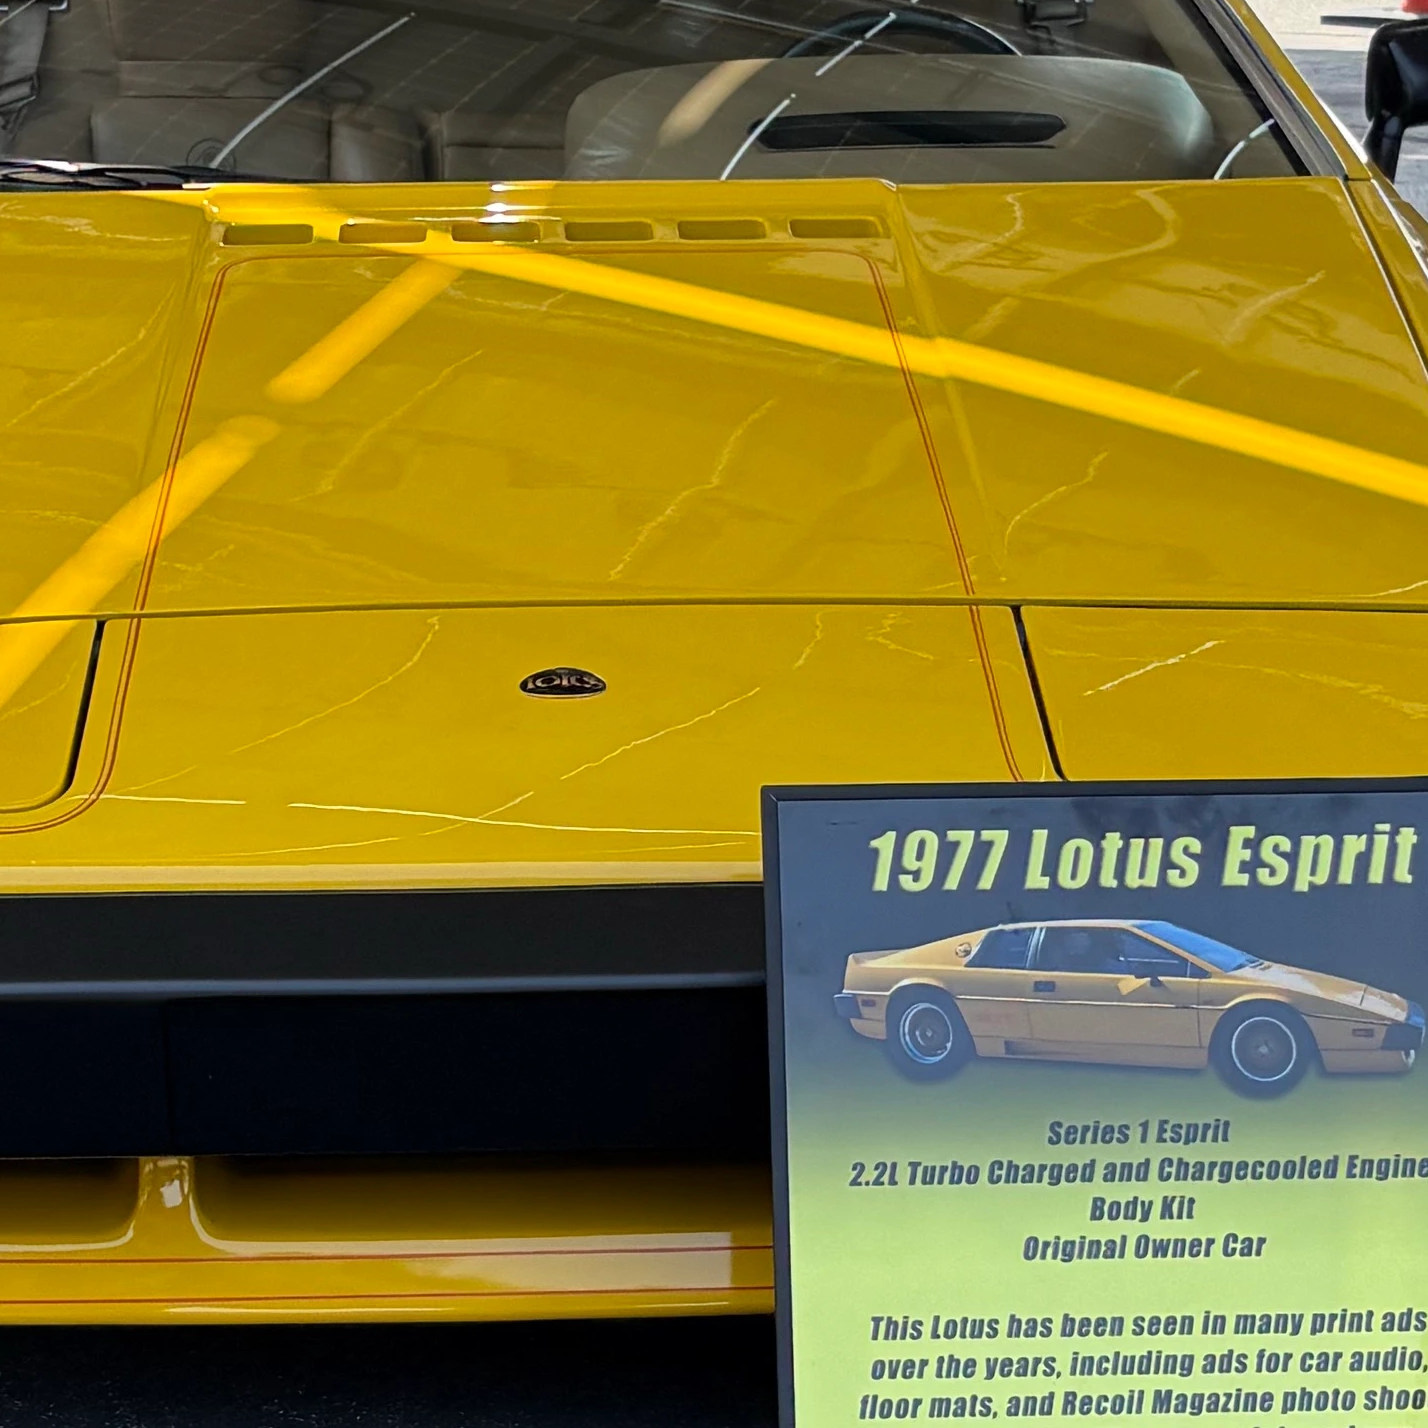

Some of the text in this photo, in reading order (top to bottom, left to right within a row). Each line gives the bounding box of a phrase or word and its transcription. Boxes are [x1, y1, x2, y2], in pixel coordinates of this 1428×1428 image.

[868, 823, 1418, 892] 1977 Lotus Esprit
[1047, 1118, 1231, 1146] Series 1 Esprit
[848, 1161, 899, 1187] 2.2L
[907, 1160, 981, 1187] Turbo
[986, 1158, 1097, 1187] Charged
[1101, 1157, 1151, 1184] and
[1157, 1154, 1340, 1185] Chargecooled
[1089, 1194, 1197, 1224] Body Kit
[1022, 1232, 1268, 1264] Original Owner Car
[870, 1306, 1428, 1342] This Lotus has been seen in many print ads
[870, 1345, 1428, 1381] over the years, including ads for car audio,
[858, 1393, 924, 1421] floor
[927, 1393, 999, 1420] mats,
[1005, 1390, 1056, 1418] and
[1060, 1388, 1146, 1417] Recoil
[1150, 1387, 1275, 1417] Magazine
[1280, 1386, 1357, 1416] photo
